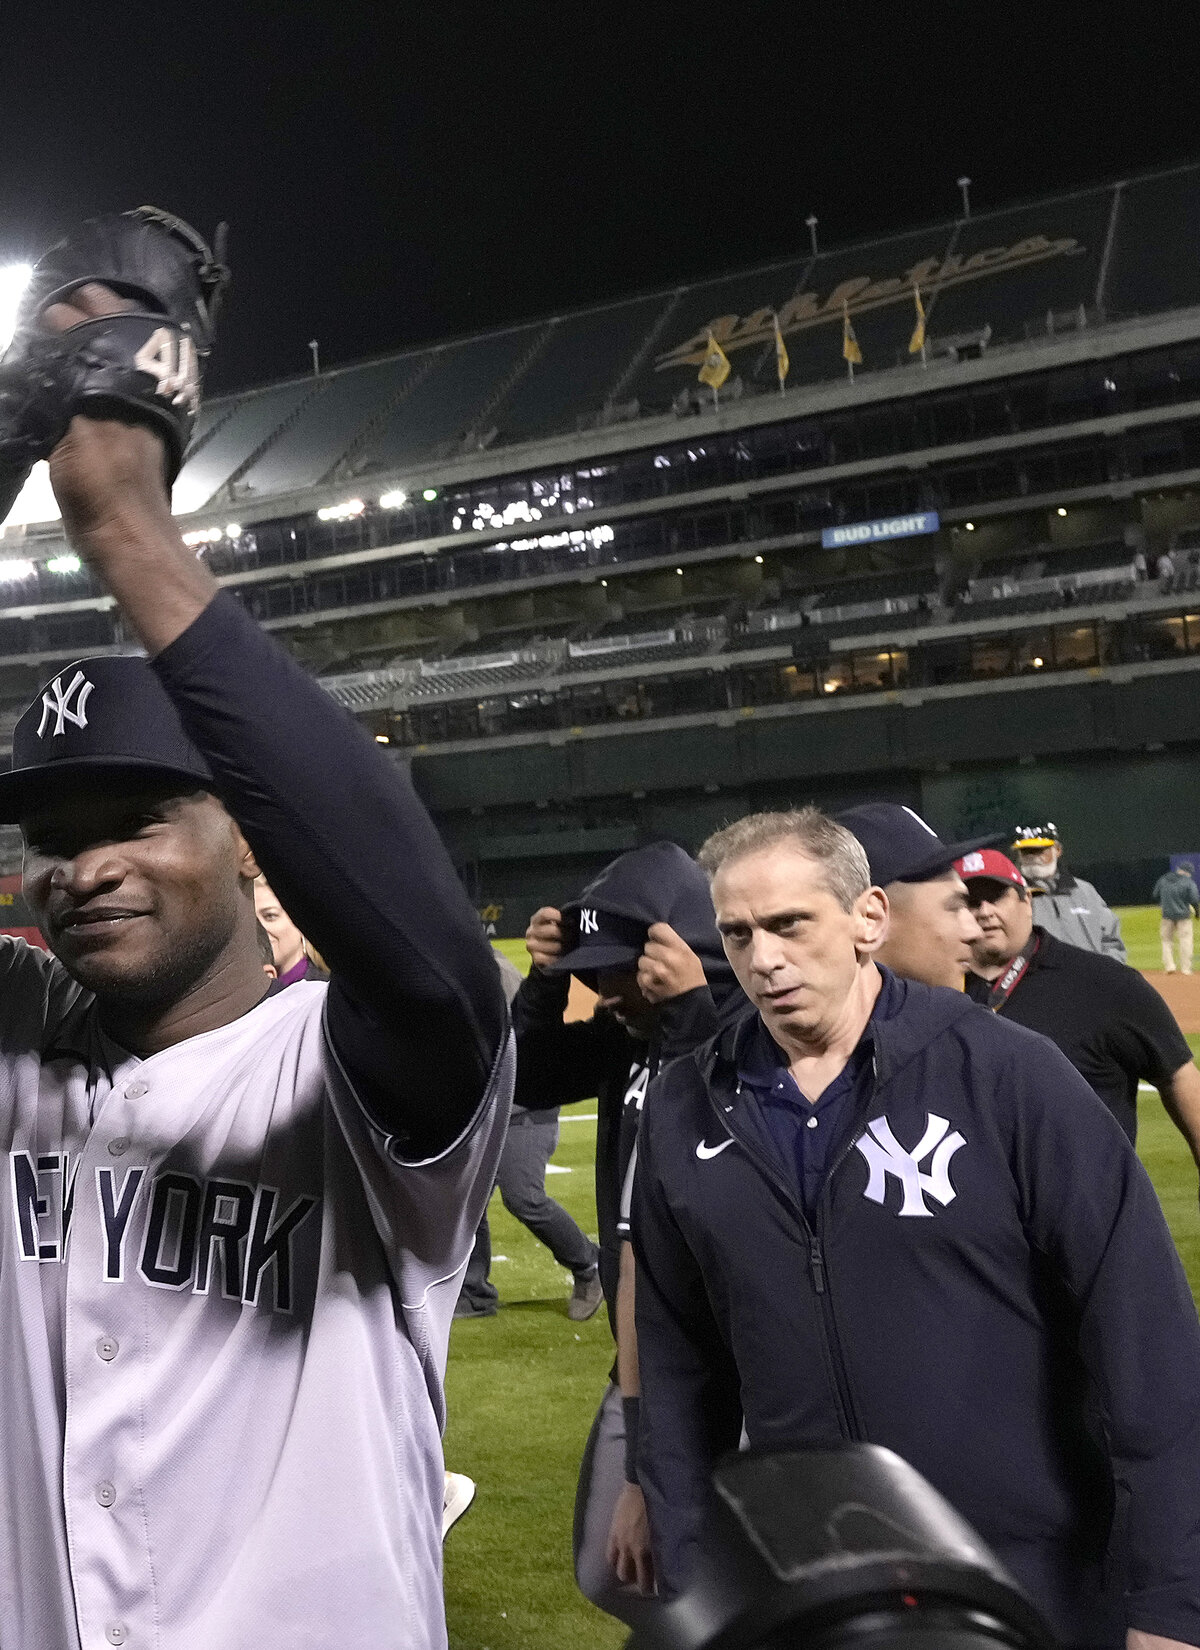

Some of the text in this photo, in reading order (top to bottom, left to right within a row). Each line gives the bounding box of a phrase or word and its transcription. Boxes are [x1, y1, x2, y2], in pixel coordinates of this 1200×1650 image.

[833, 516, 927, 543] BUD LIGHT
[36, 670, 96, 739] NY
[579, 908, 599, 934] NY
[855, 1112, 968, 1217] NY
[95, 1165, 318, 1315] YORK
